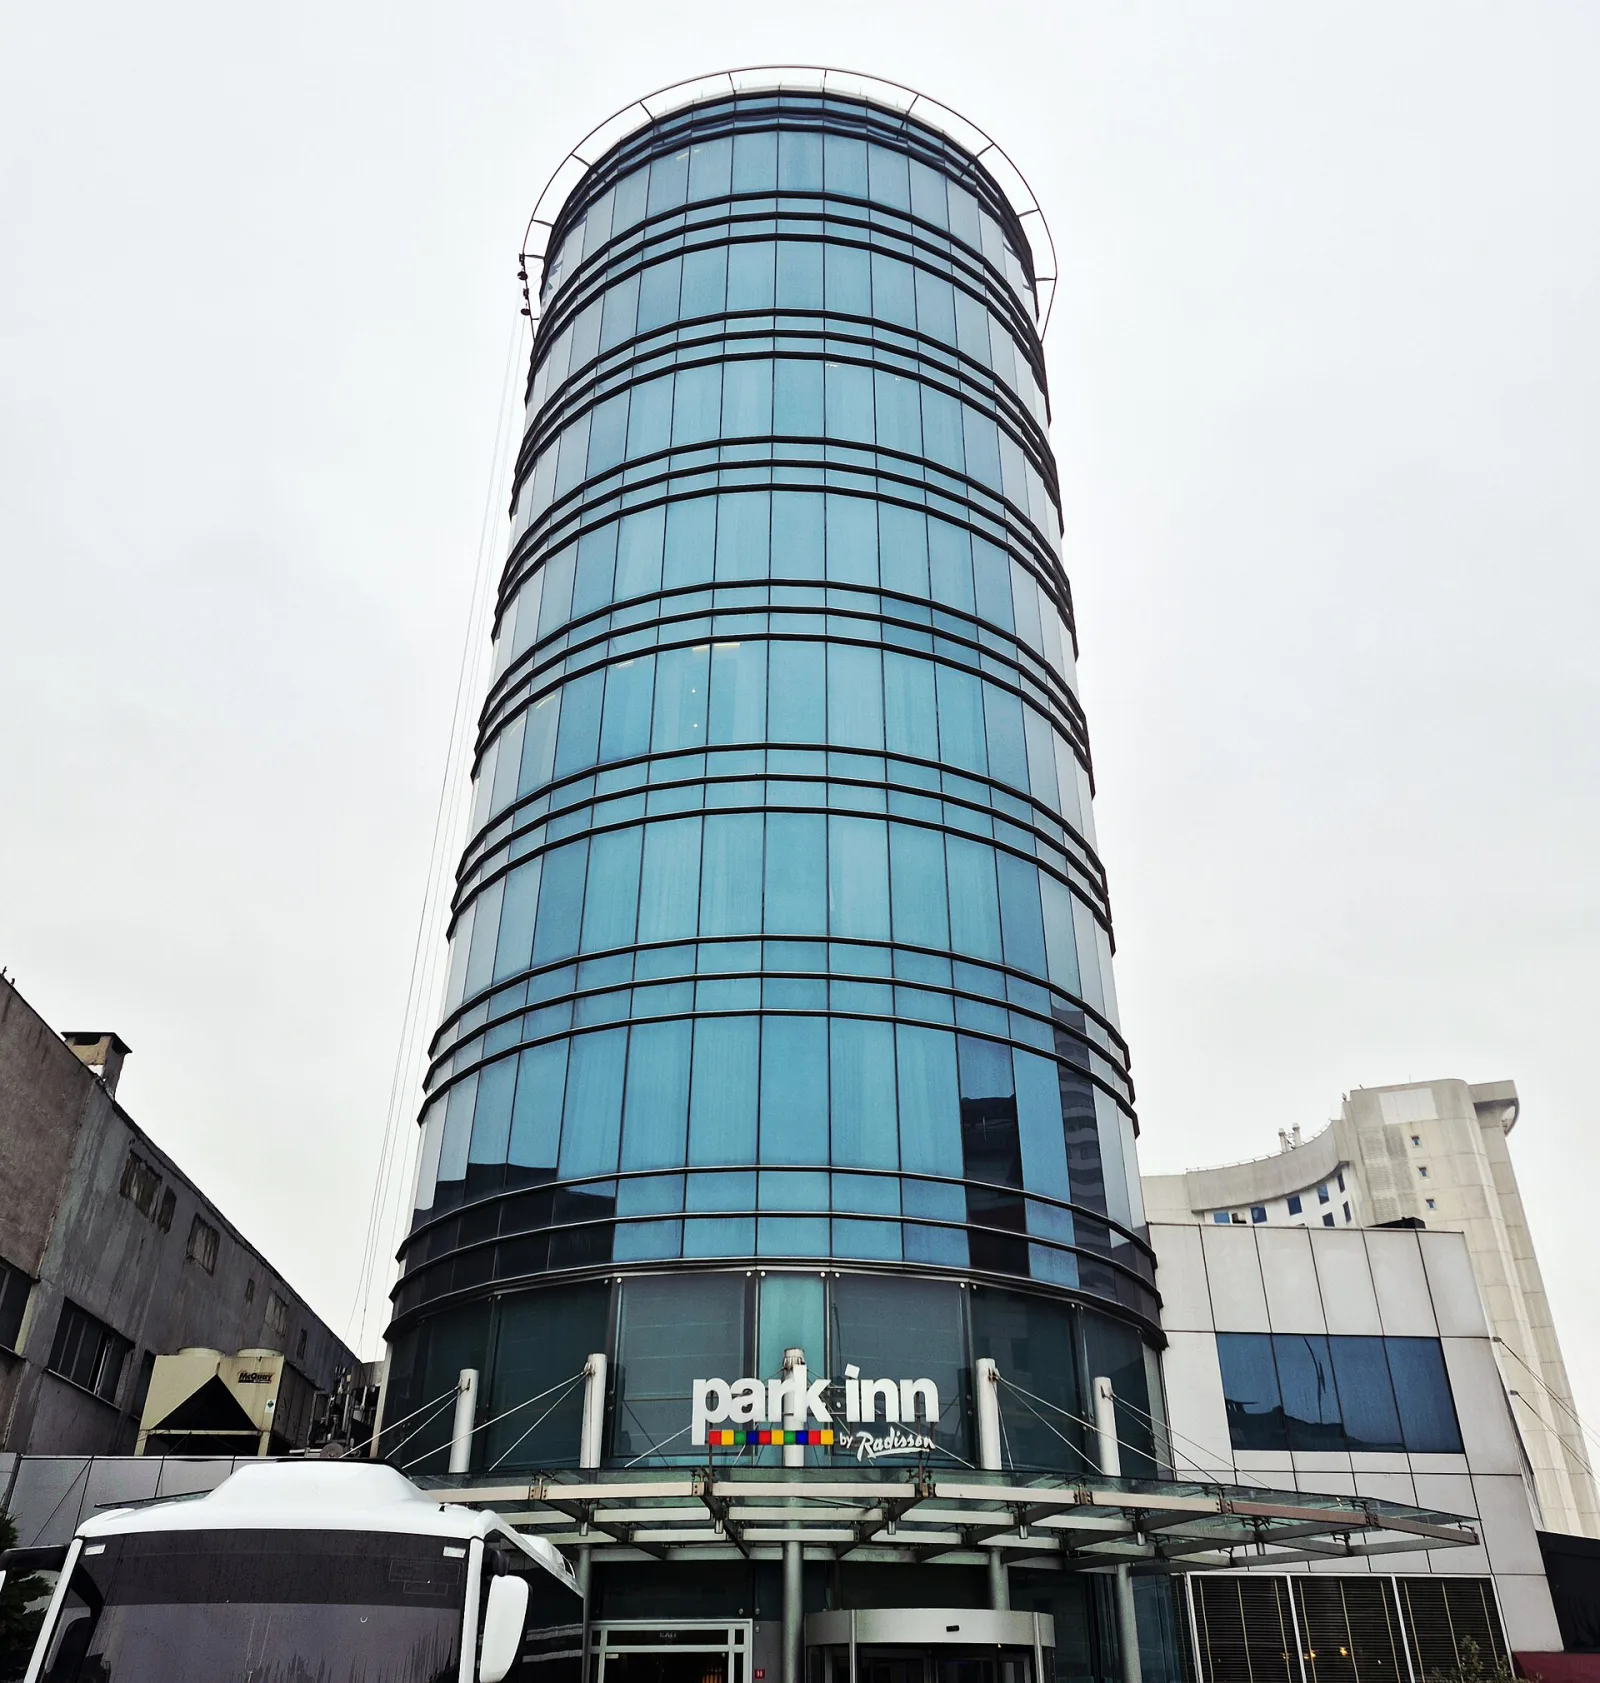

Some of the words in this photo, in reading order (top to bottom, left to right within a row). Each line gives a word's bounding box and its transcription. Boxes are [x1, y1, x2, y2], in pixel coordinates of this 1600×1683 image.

[692, 1364, 834, 1446] park
[845, 1363, 940, 1422] inn
[839, 1432, 854, 1449] by
[856, 1425, 936, 1462] Radisson
